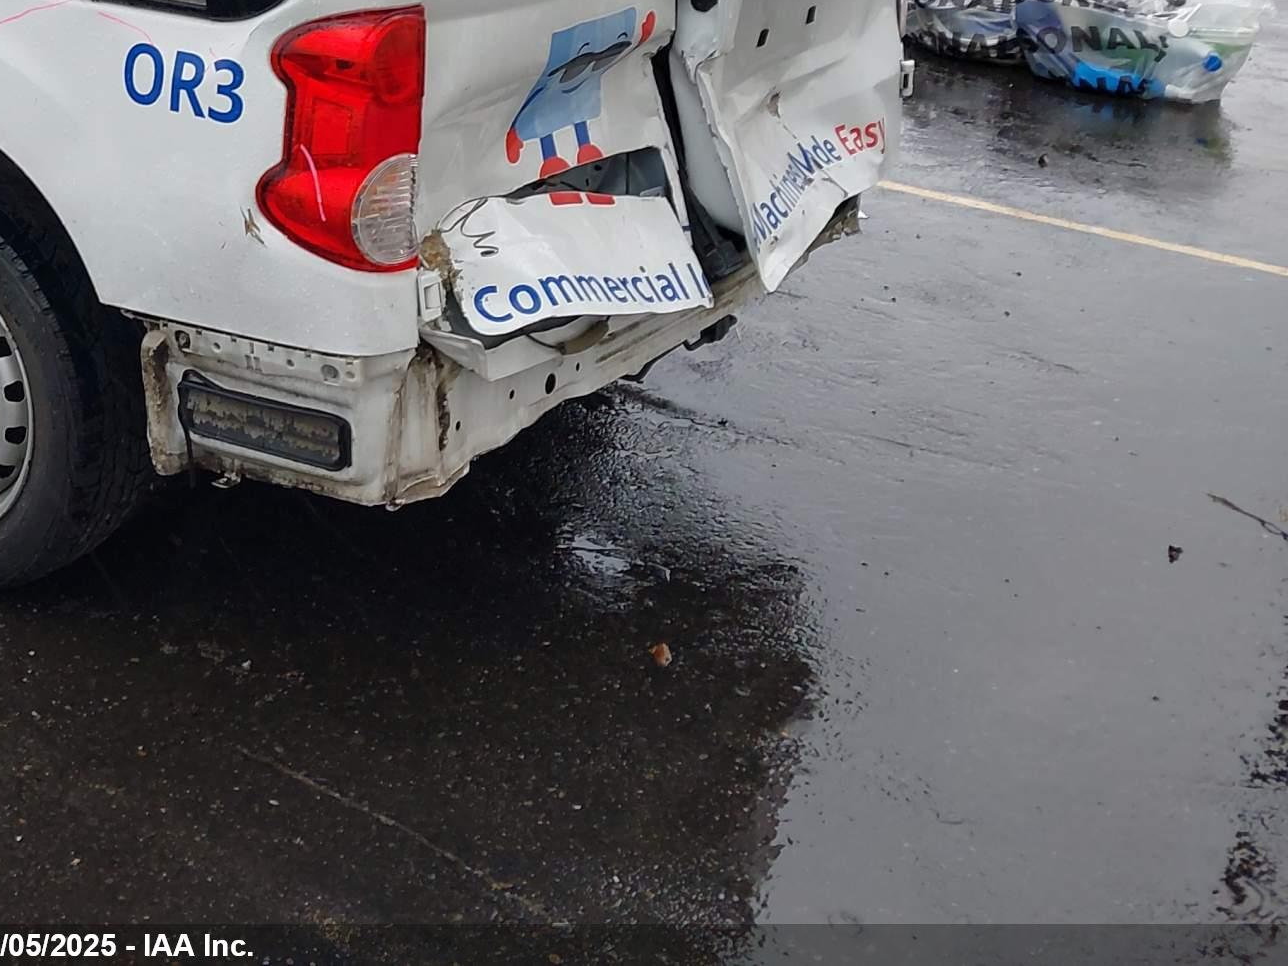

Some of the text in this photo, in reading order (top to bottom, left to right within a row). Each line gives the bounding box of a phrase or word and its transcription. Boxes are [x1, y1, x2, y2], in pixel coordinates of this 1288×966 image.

[123, 42, 245, 124] OR3
[834, 117, 886, 155] Easy
[473, 262, 690, 323] Commercial
